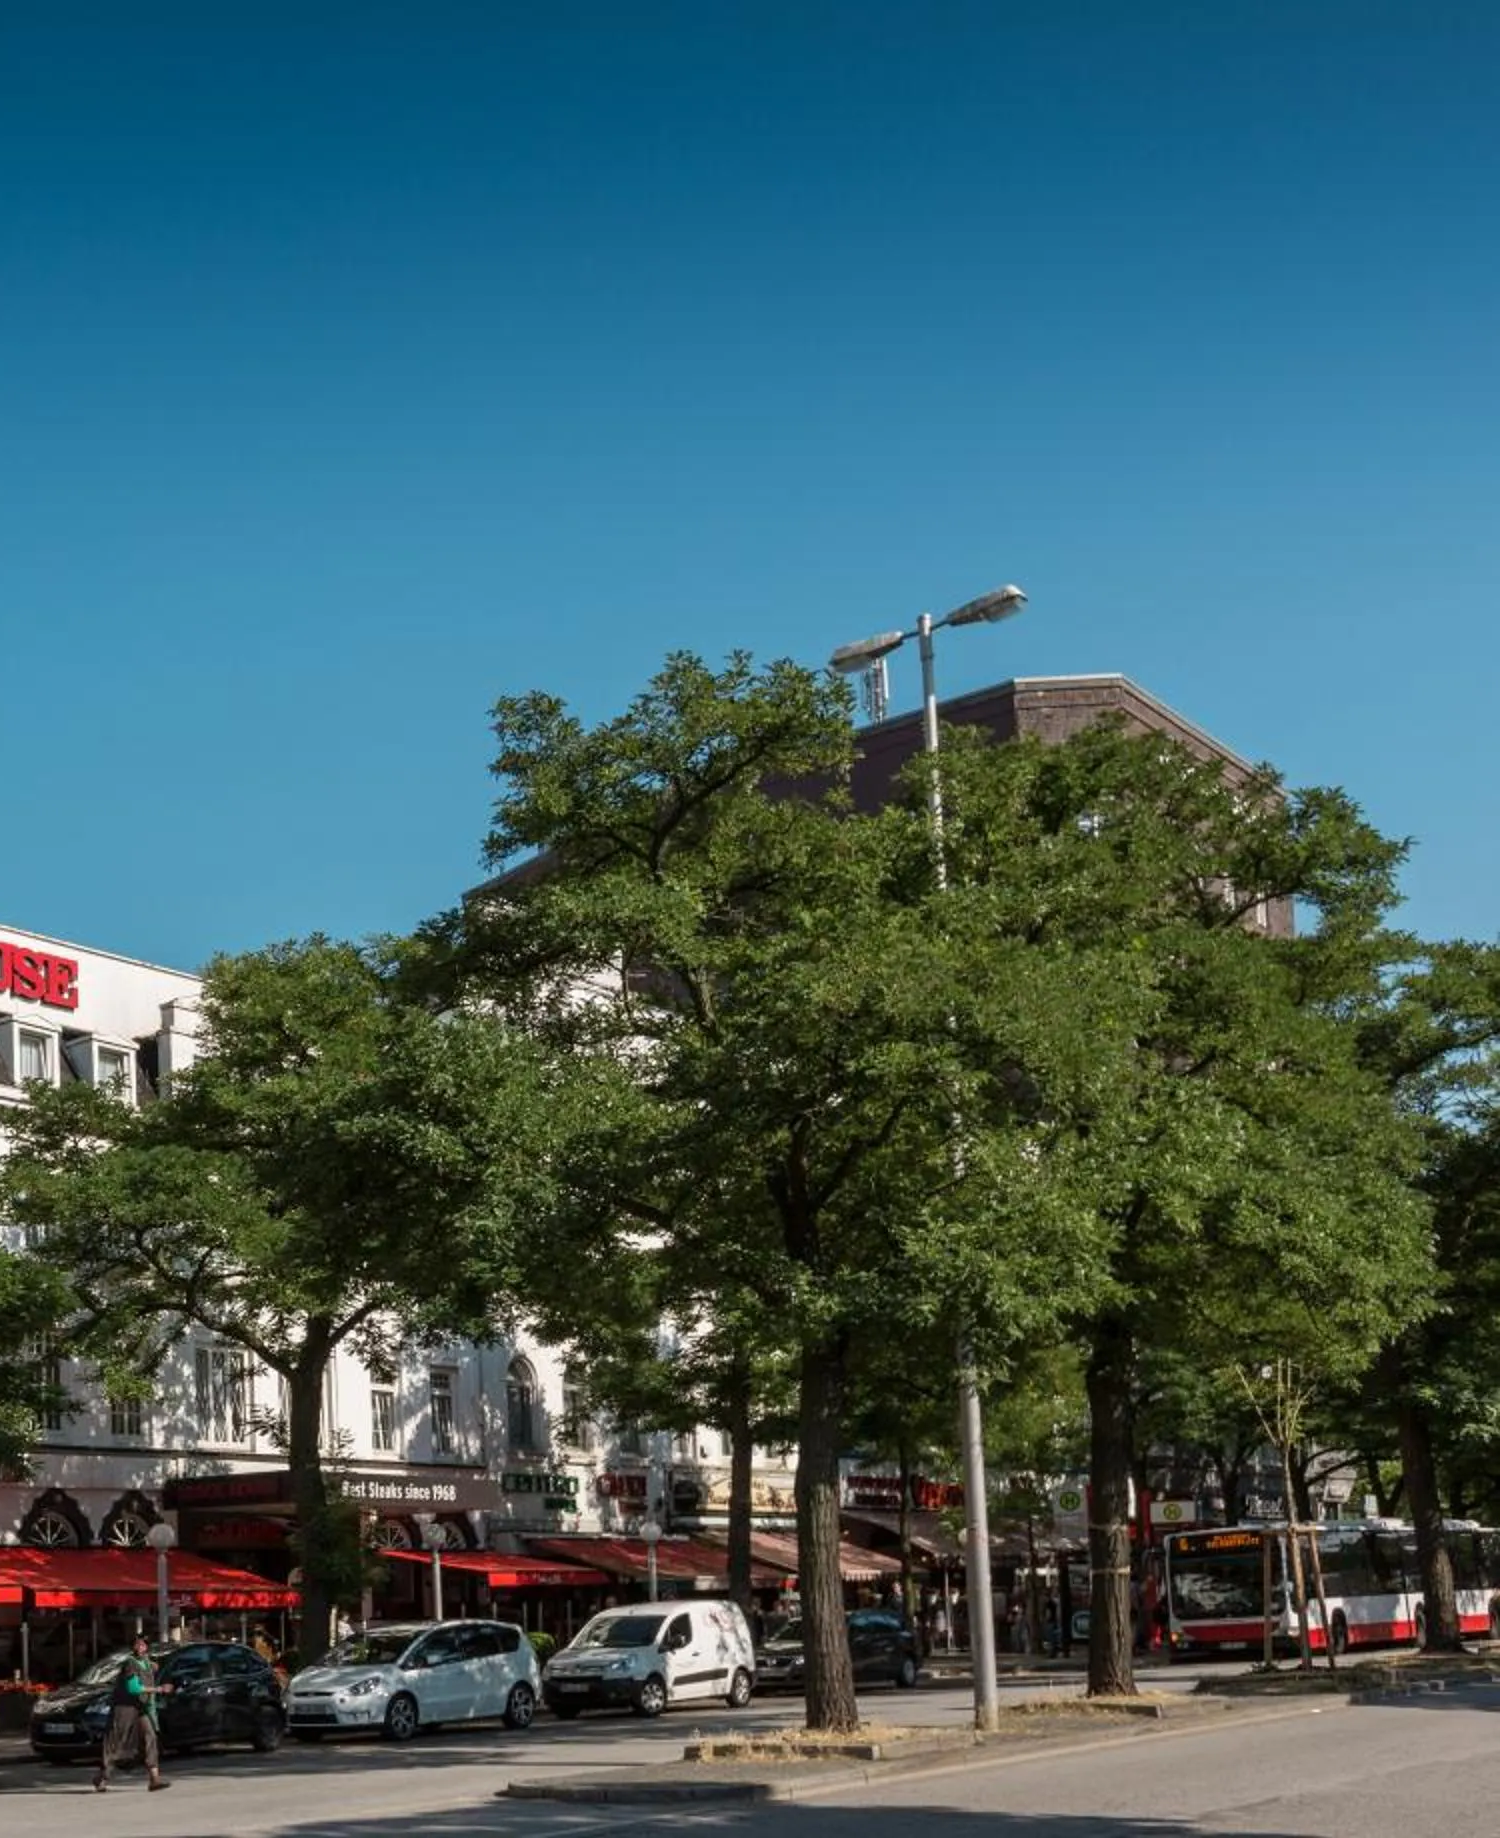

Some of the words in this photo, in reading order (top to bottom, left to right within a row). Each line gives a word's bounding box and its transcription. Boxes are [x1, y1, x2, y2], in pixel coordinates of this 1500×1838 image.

[341, 1480, 365, 1497] Best
[368, 1481, 403, 1499] Steaks
[404, 1483, 431, 1500] since
[431, 1484, 457, 1501] 1968
